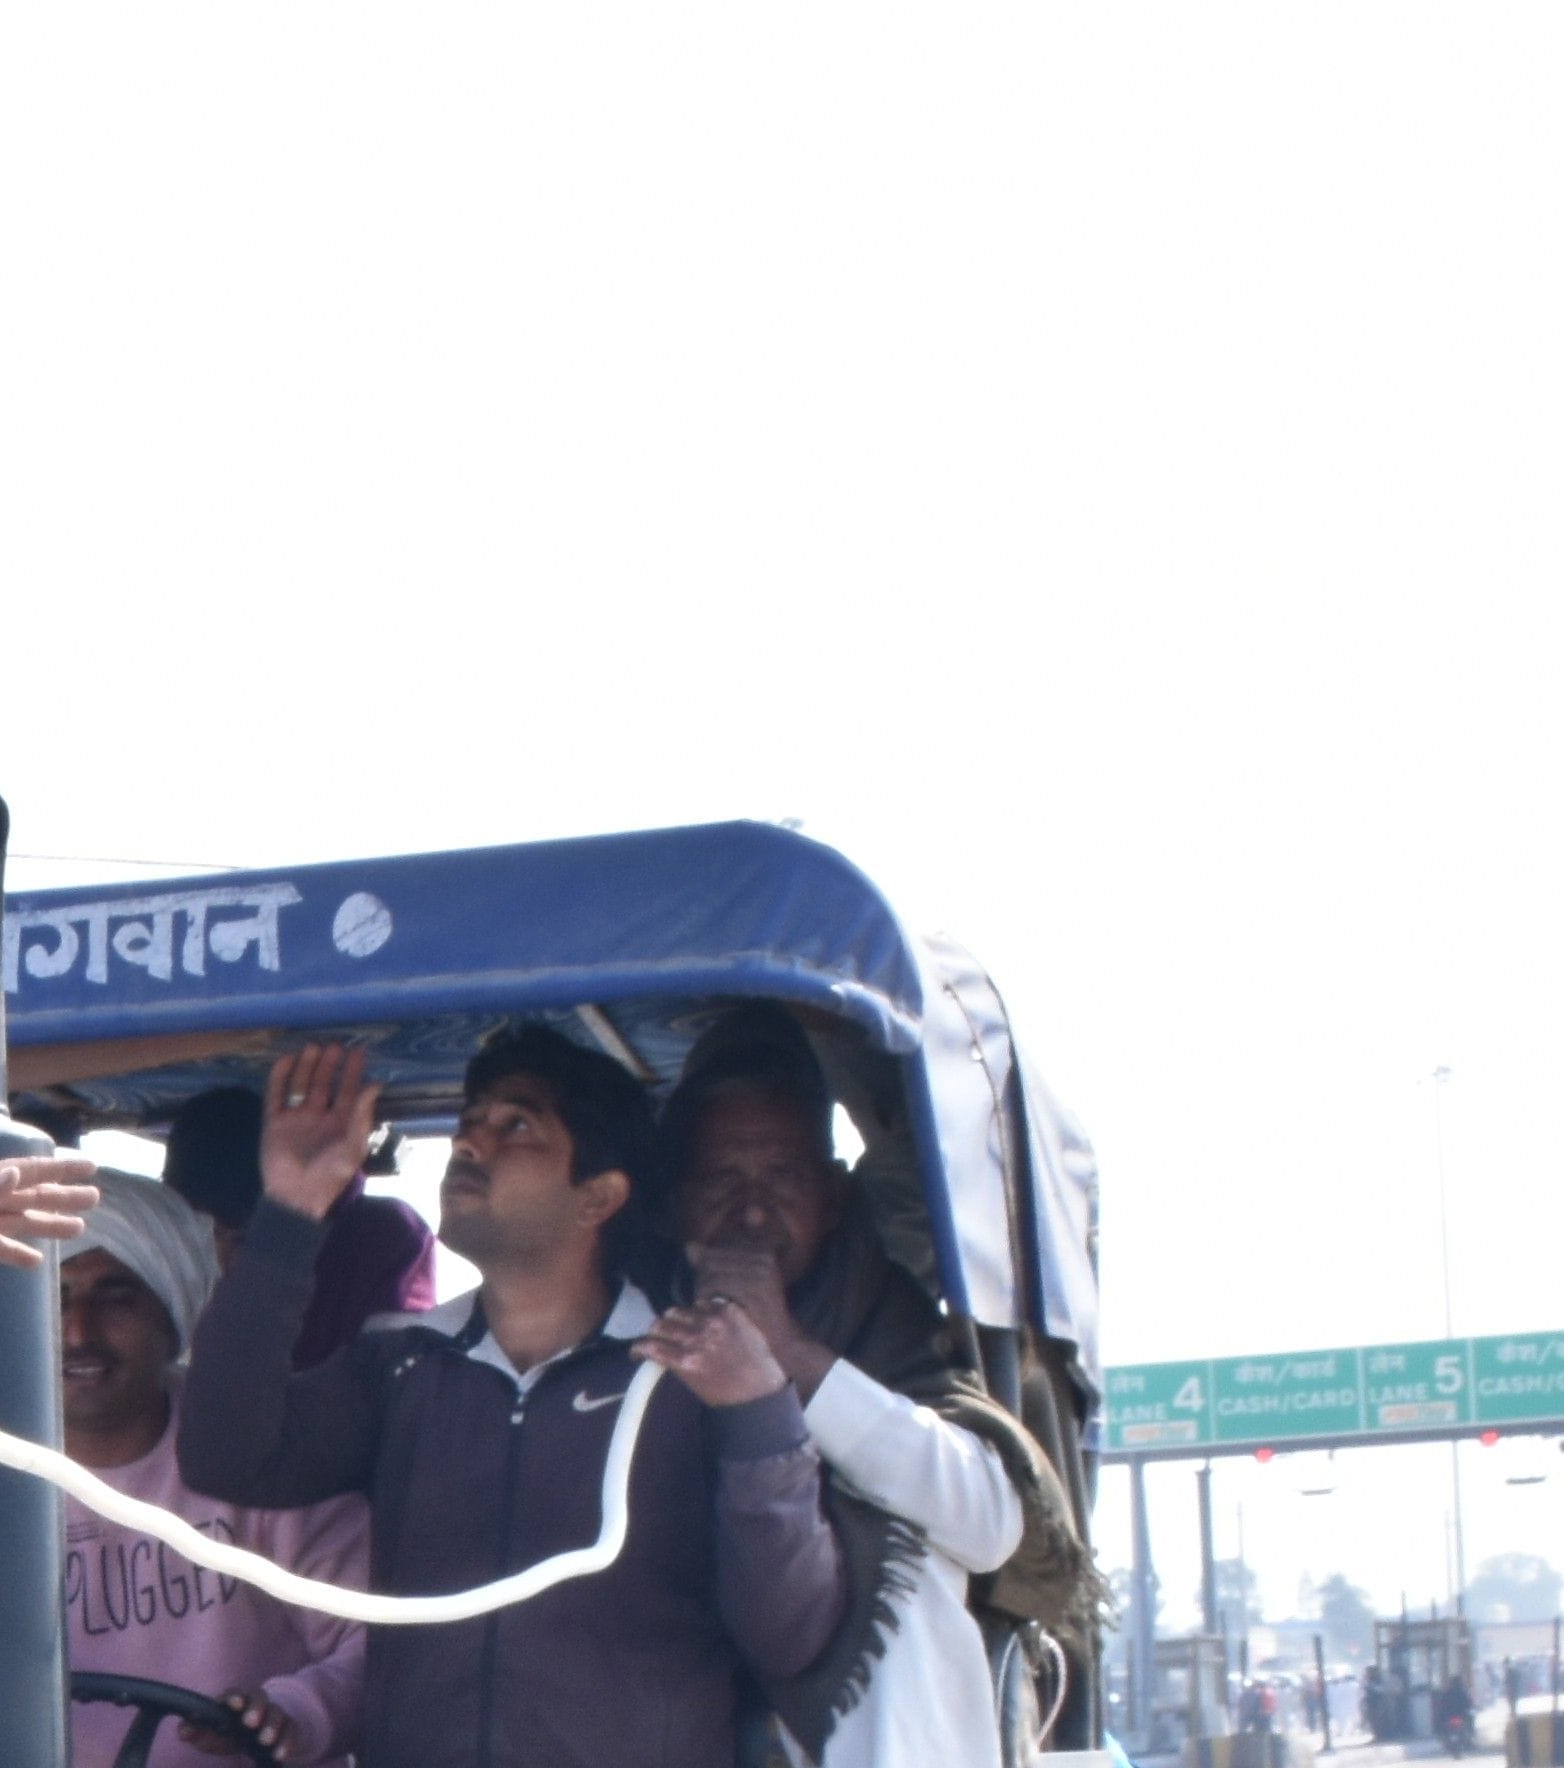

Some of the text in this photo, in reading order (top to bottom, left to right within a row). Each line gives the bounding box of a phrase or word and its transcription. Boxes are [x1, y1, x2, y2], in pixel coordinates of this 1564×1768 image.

[1435, 1355, 1464, 1395] 5
[1173, 1376, 1205, 1413] 4
[1368, 1382, 1429, 1404] LANE
[1107, 1402, 1169, 1423] LANE
